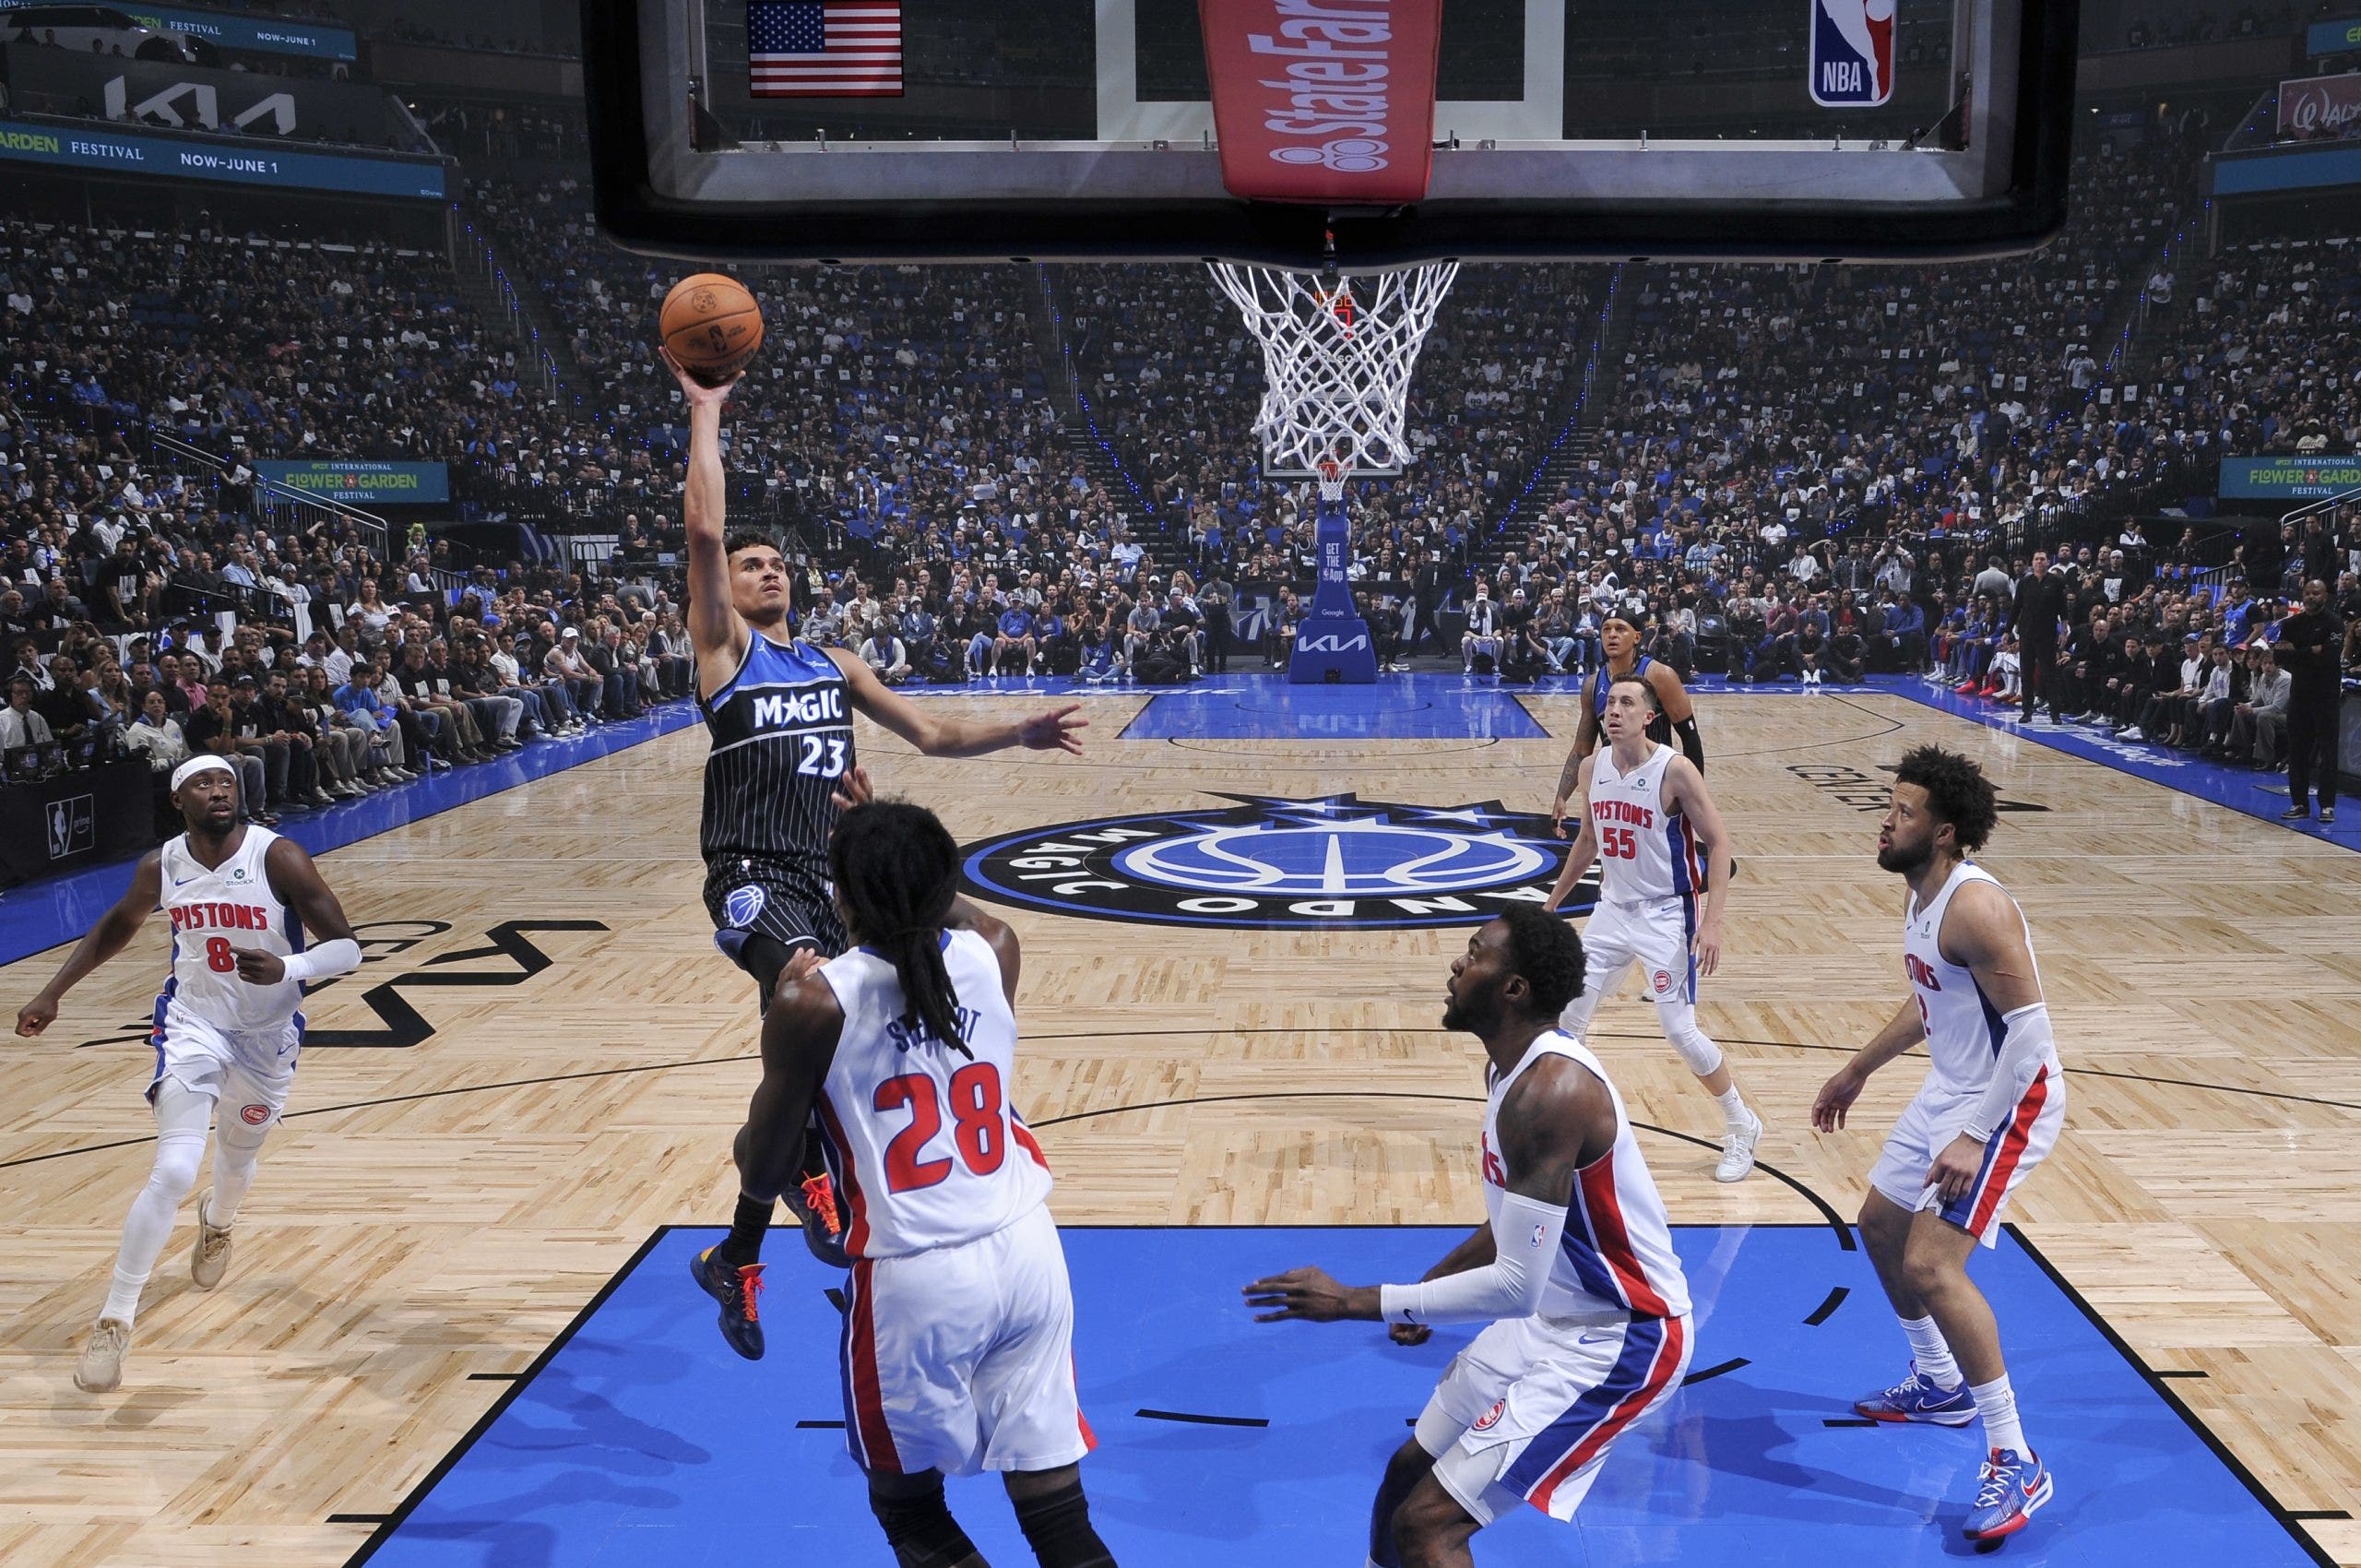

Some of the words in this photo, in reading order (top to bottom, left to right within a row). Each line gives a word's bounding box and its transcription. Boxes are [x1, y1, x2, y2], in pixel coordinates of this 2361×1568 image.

[170, 20, 222, 35] FESTIVAL
[311, 39, 315, 47] 1
[1247, 0, 1393, 137] StateFar
[1822, 61, 1862, 93] NBA
[104, 75, 296, 136] KIA
[71, 141, 145, 160] FESTIVAL
[271, 161, 279, 174] 1
[331, 463, 392, 471] INTERNATIONAL
[2294, 458, 2356, 467] INTERNATIONAL
[285, 473, 345, 489] FLOWER
[358, 473, 418, 489] GARDEN
[2249, 468, 2305, 484] FLOWER
[334, 491, 375, 500] FESTIVAL
[2292, 486, 2334, 495] FESTIVAL
[1325, 542, 1340, 555] GET
[1326, 555, 1340, 567] THE
[1329, 569, 1344, 583] App
[1321, 609, 1345, 617] Google
[1298, 635, 1367, 652] KIA
[797, 735, 846, 778] 23
[1592, 800, 1654, 829] PISTONS
[1603, 826, 1636, 860] 55
[169, 902, 267, 931] PISTONS
[206, 936, 235, 973] 8
[872, 1061, 1005, 1195] 28
